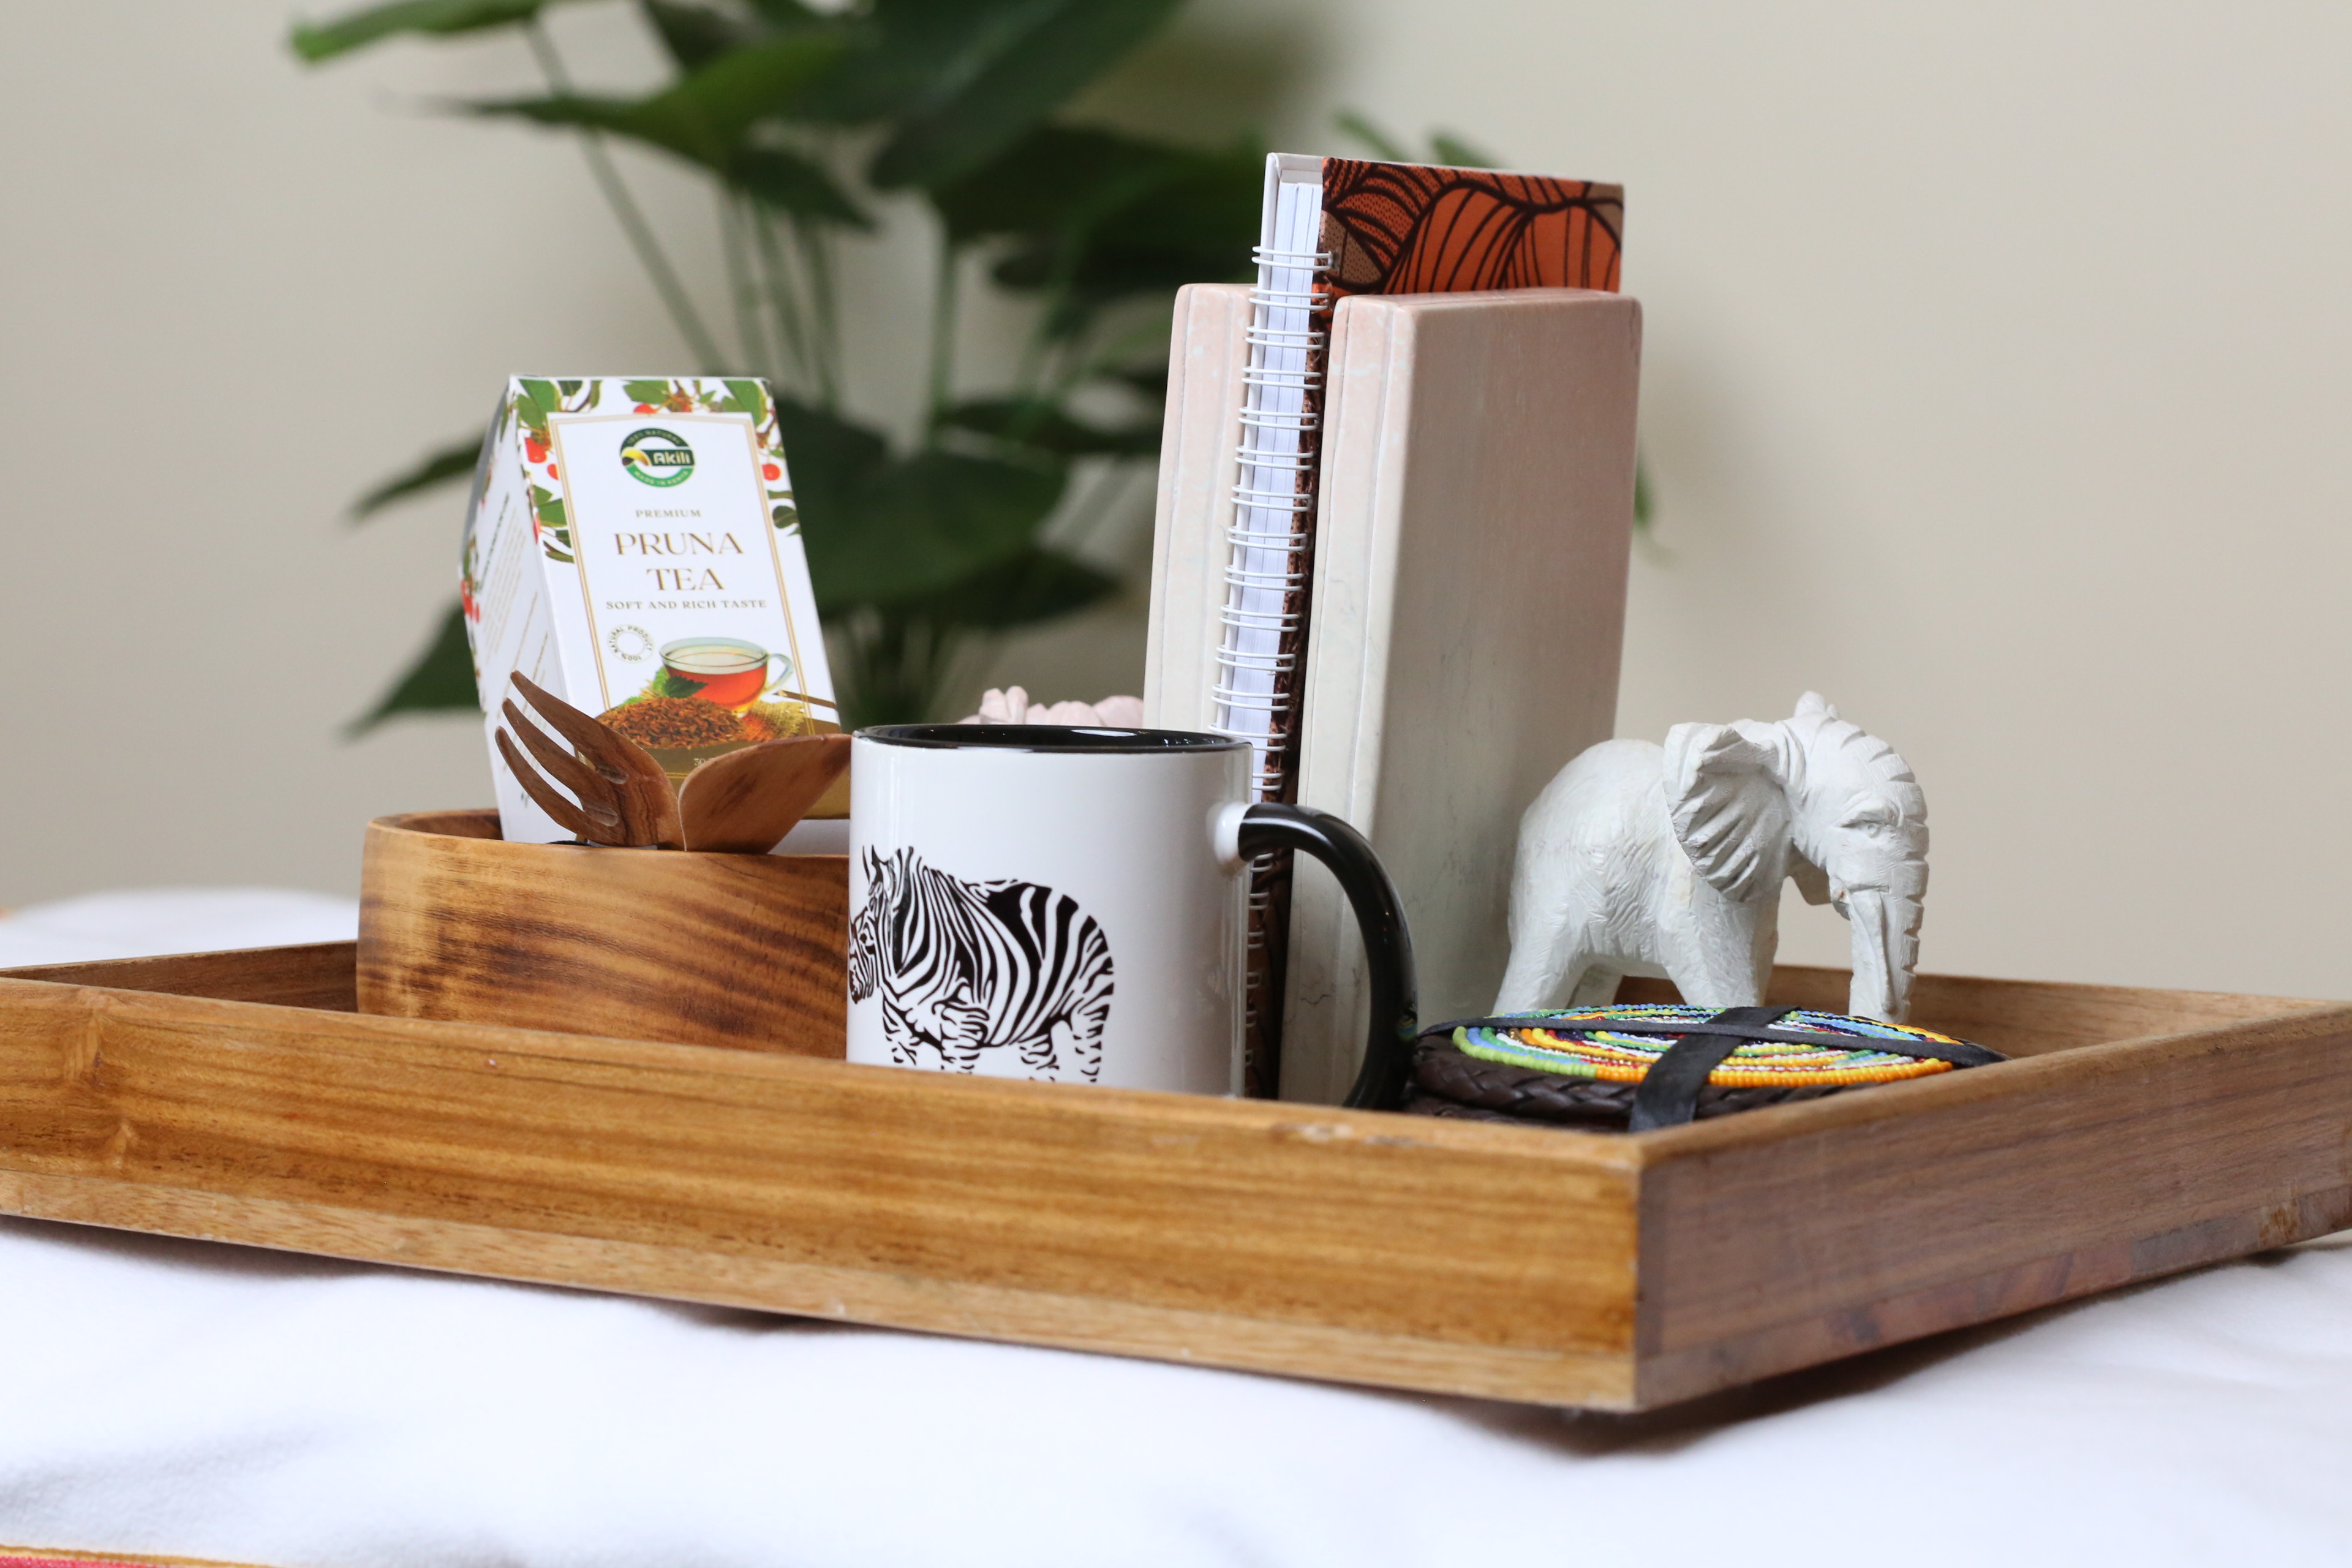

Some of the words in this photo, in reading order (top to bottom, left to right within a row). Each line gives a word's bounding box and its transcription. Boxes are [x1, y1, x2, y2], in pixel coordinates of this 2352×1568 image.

[636, 509, 701, 518] PREMIUM
[614, 532, 744, 555] PRUNA
[646, 568, 725, 590] TEA
[606, 601, 643, 609] SOFT
[682, 600, 717, 609] RICH
[721, 599, 767, 608] TASTE
[609, 627, 624, 654] NATURAL
[628, 625, 652, 650] PRODUCT
